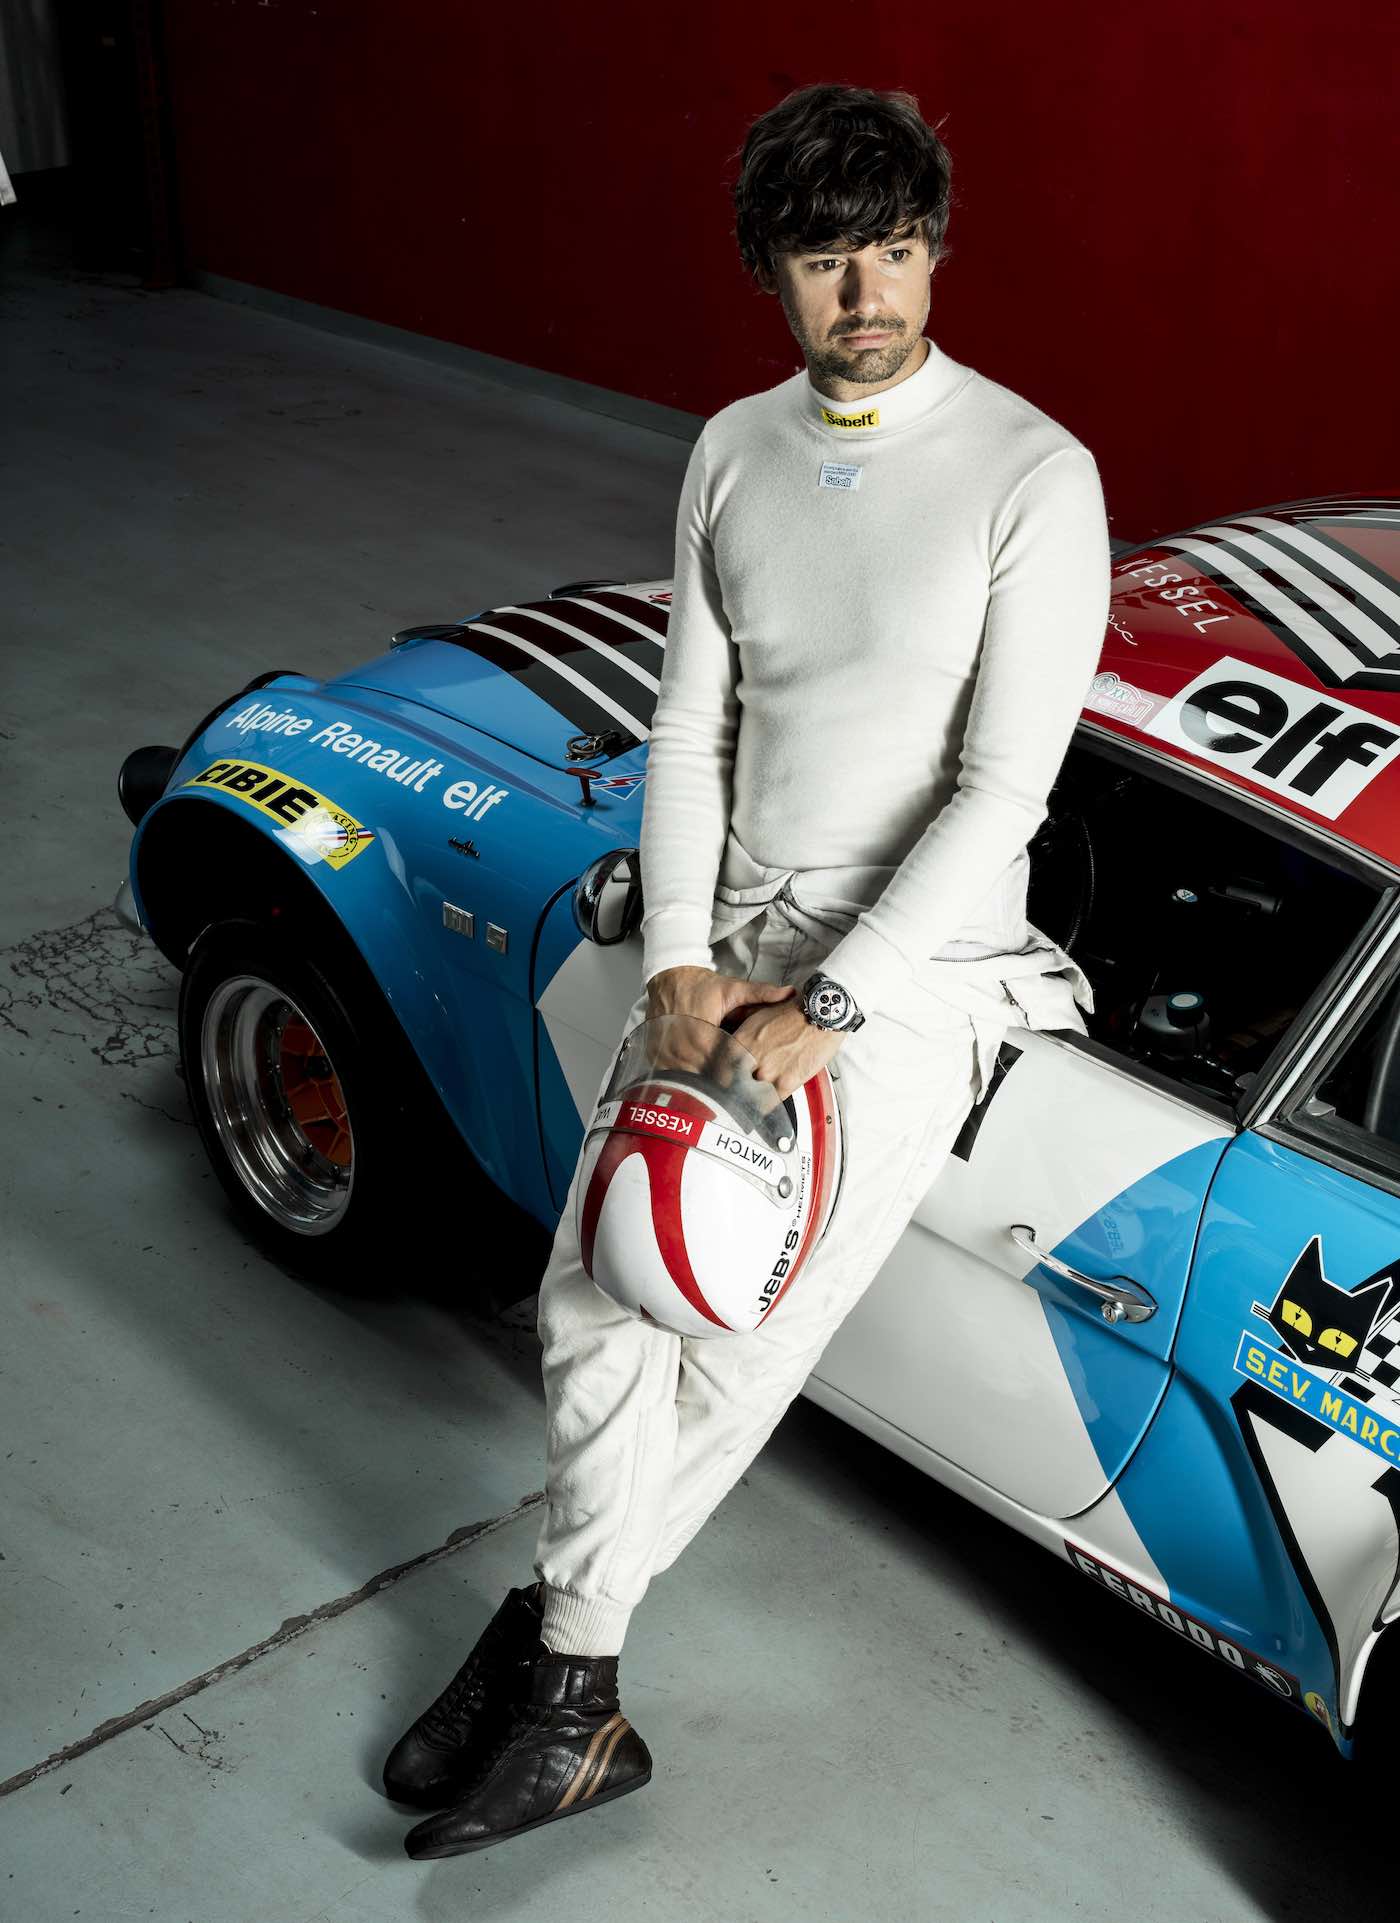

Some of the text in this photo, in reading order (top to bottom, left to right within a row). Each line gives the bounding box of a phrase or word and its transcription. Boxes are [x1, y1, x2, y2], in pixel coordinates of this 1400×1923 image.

[825, 411, 875, 427] Sabelt
[1114, 558, 1230, 634] KESSEL
[226, 703, 509, 821] Alpine Renault elf
[1179, 680, 1400, 797] elf
[629, 1107, 693, 1135] KESSEL
[716, 1133, 773, 1175] WATCH
[1245, 1347, 1400, 1461] S.E.V. MARC
[1075, 1551, 1246, 1669] FERODO
